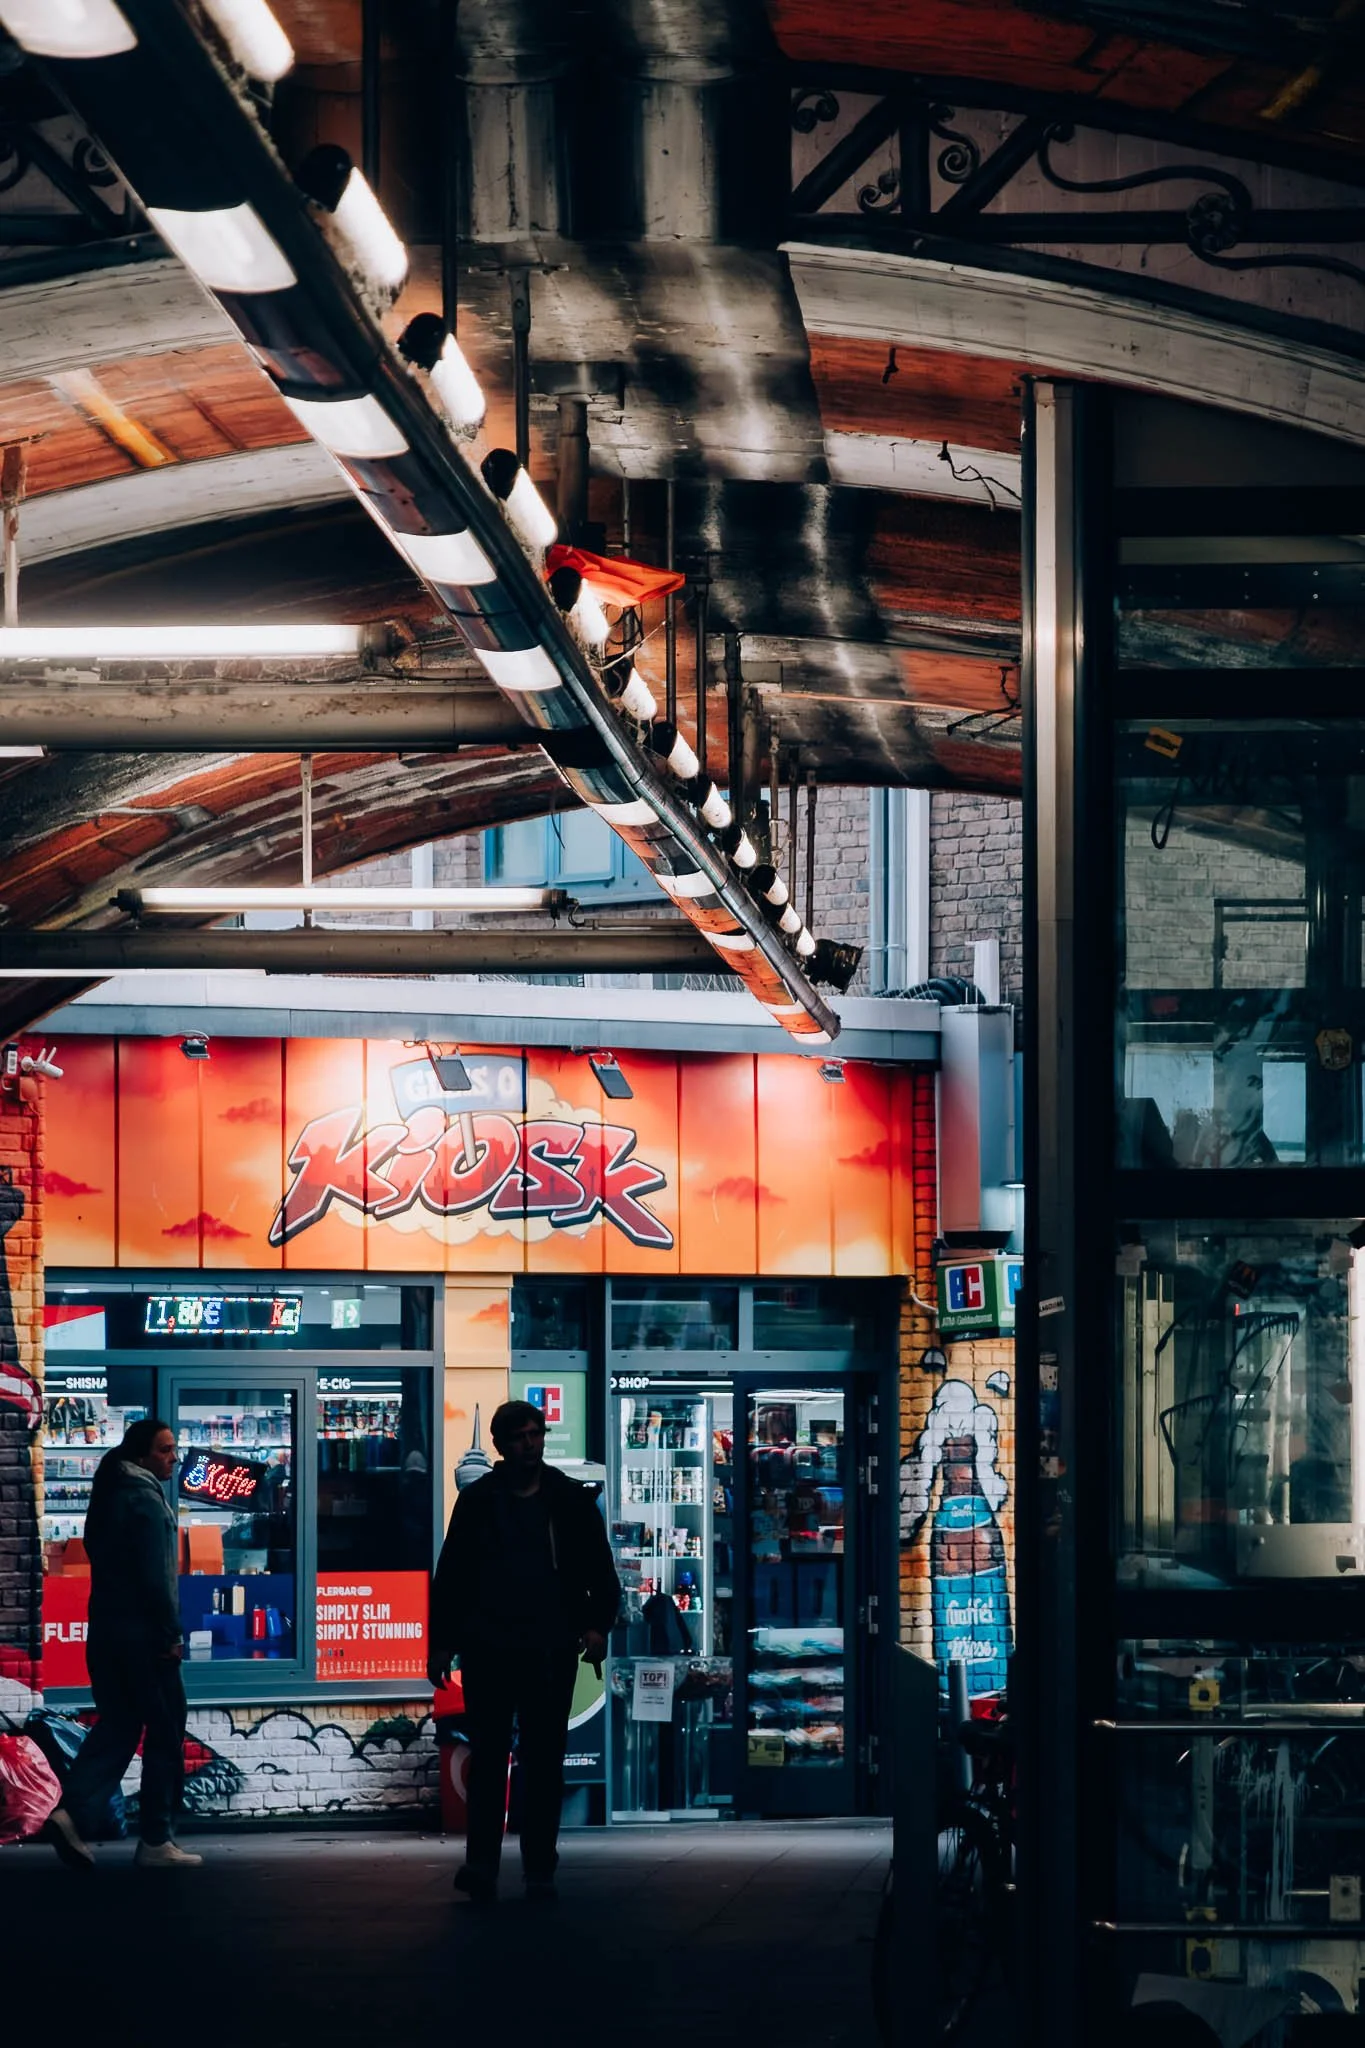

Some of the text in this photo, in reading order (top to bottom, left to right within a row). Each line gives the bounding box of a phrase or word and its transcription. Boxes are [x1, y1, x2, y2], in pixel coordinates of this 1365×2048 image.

[65, 1377, 107, 1389] SHISHA
[619, 1377, 650, 1388] SHOP
[201, 1464, 256, 1499] Kaffee
[316, 1603, 391, 1621] SIMPLY SLIM
[316, 1622, 422, 1640] SIMPLY STUNNING
